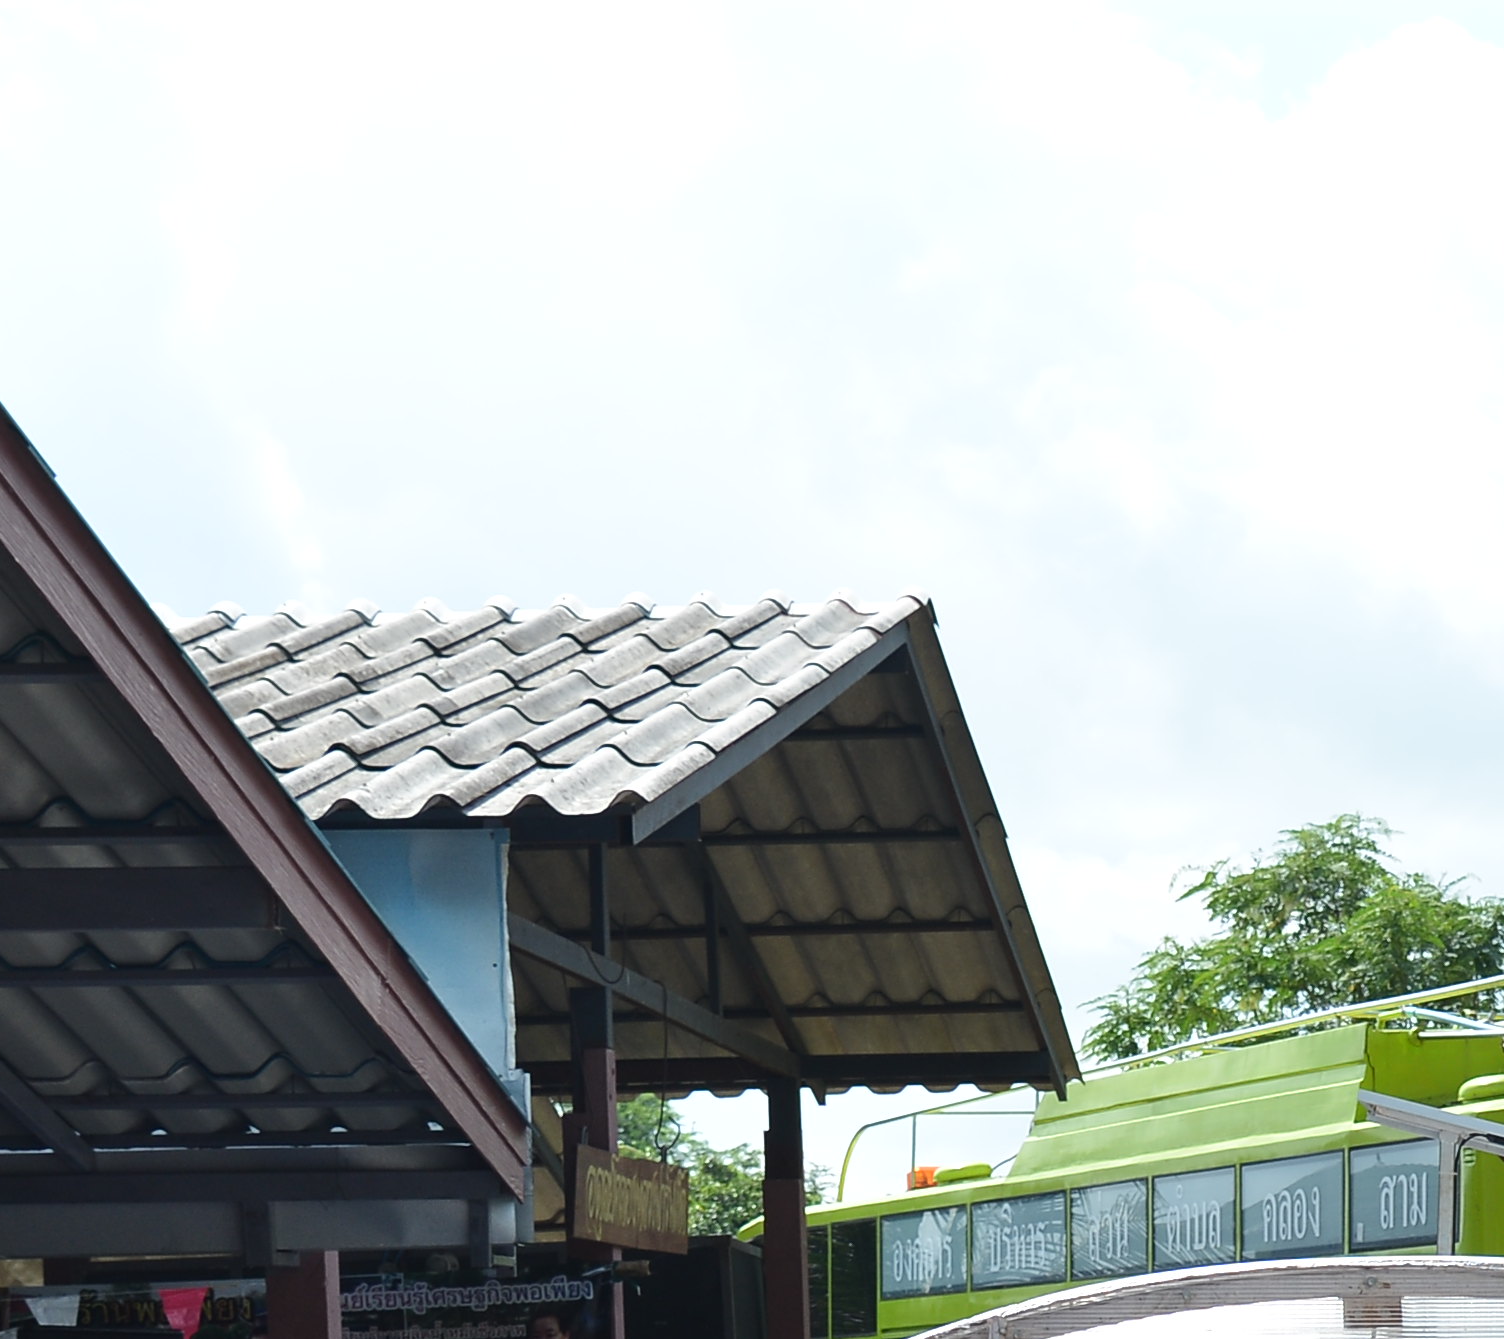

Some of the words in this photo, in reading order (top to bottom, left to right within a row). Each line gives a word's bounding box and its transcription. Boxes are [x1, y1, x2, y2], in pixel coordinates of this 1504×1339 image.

[1166, 1184, 1222, 1250] ตำบล
[1262, 1185, 1320, 1242] คลอง
[1379, 1171, 1428, 1230] สาม
